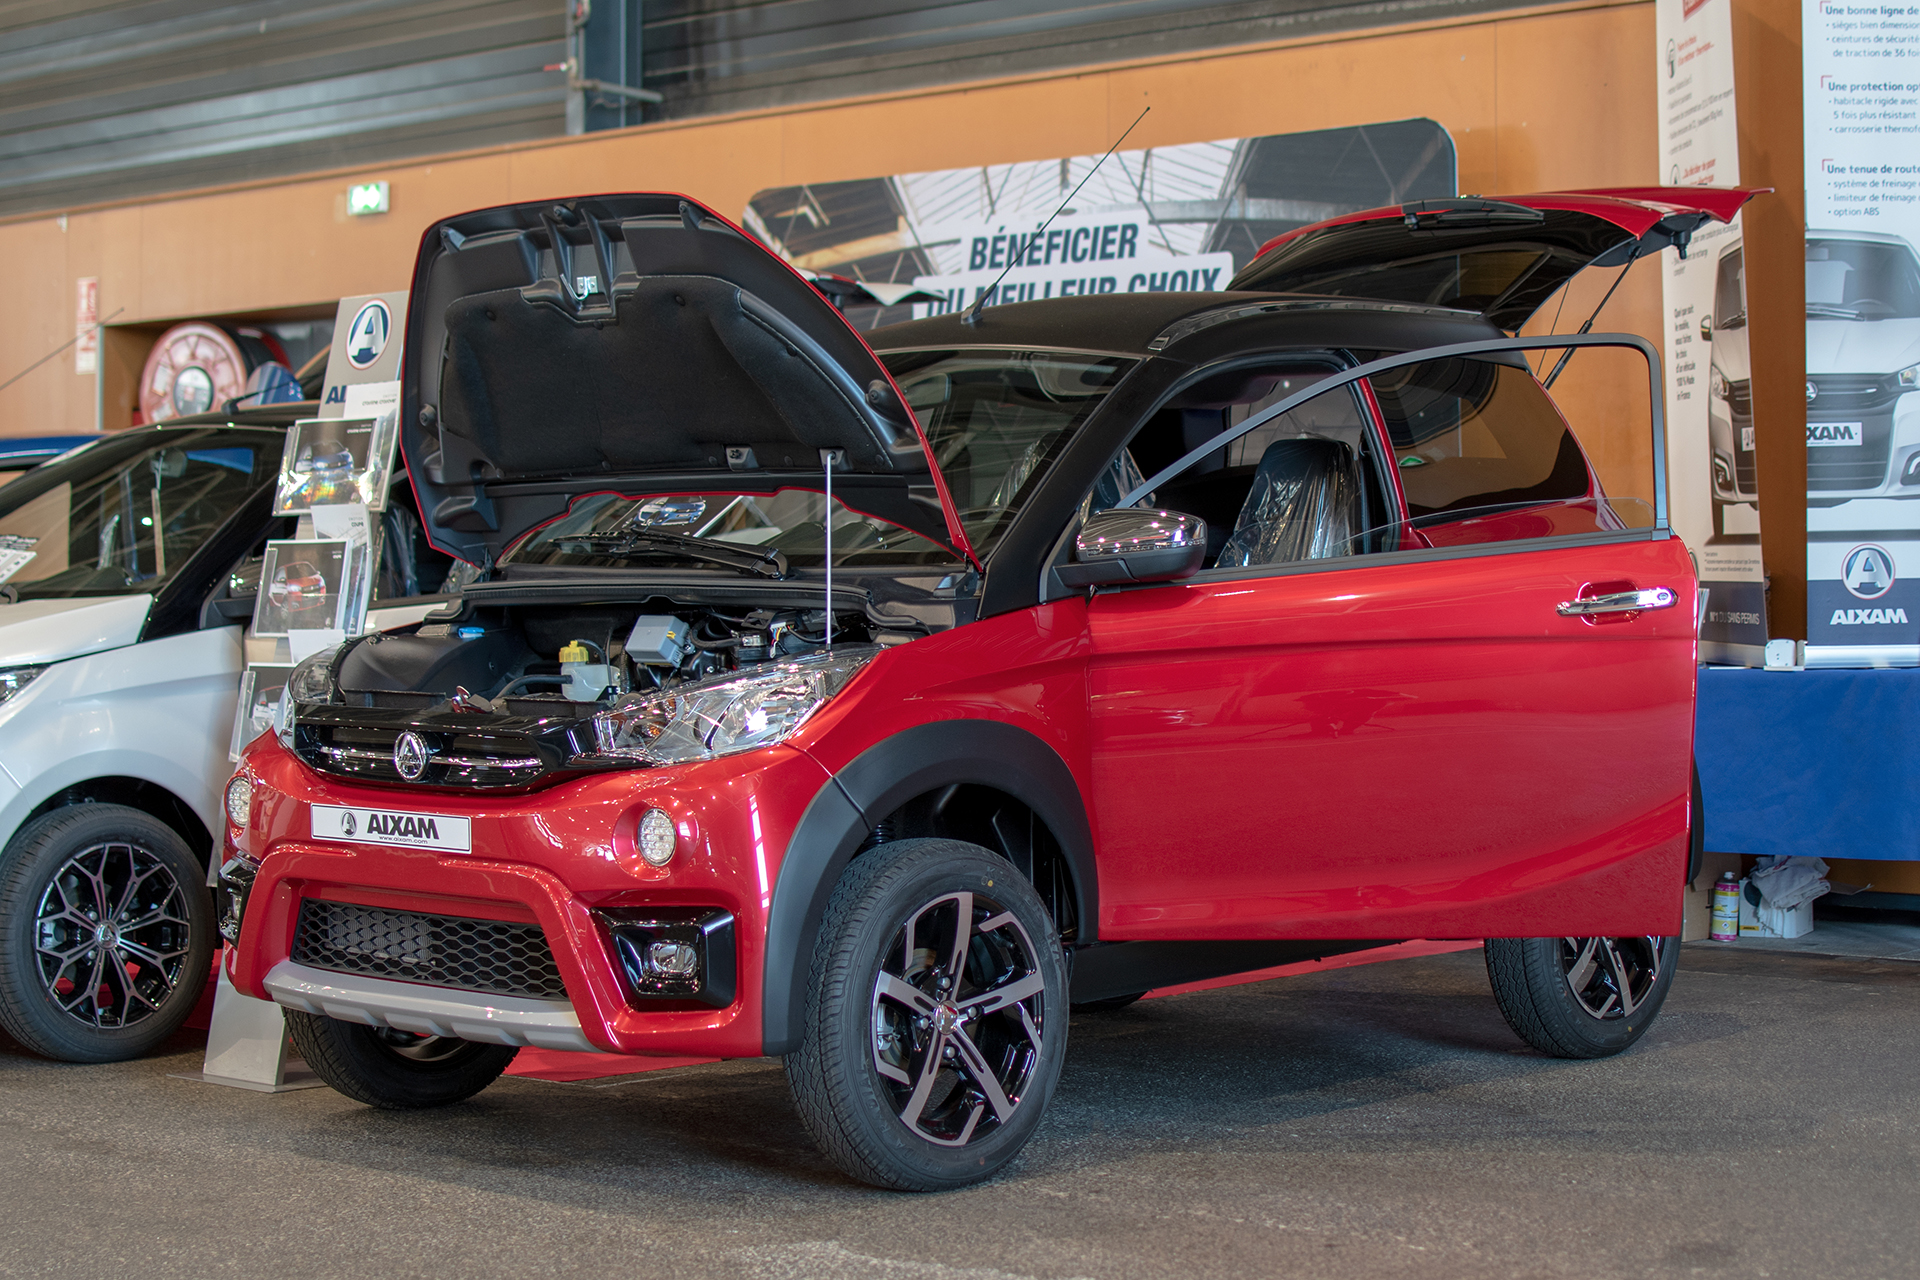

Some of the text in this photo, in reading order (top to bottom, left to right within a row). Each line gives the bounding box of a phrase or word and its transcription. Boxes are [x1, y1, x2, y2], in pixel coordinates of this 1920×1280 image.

[1826, 6, 1920, 18] Une bonne ligne de
[1860, 21, 1878, 29] bien
[1832, 35, 1871, 43] ceintures
[1874, 35, 1884, 43] de
[1833, 49, 1843, 57] de
[1846, 49, 1880, 57] traction
[1882, 49, 1892, 57] de
[1894, 48, 1905, 57] 36
[1828, 82, 1847, 91] Une
[1850, 82, 1904, 93] protection
[1834, 97, 1872, 105] habitacle
[1874, 97, 1898, 107] rigide
[1834, 110, 1916, 120] 5 fois plus résistant
[1827, 165, 1846, 174] Une
[1850, 165, 1878, 174] tenue
[1880, 164, 1892, 174] de
[1834, 180, 1867, 190] système
[1882, 180, 1916, 190] freinage
[1869, 194, 1880, 202] de
[1882, 193, 1916, 204] freinage
[1834, 207, 1880, 217] option ABS
[968, 222, 1139, 271] BÉNÉFICIER
[1127, 267, 1221, 292] CHOIX
[1830, 608, 1908, 625] AIXAM
[366, 814, 440, 840] AIXAM
[379, 835, 428, 844] www.aixam.com
